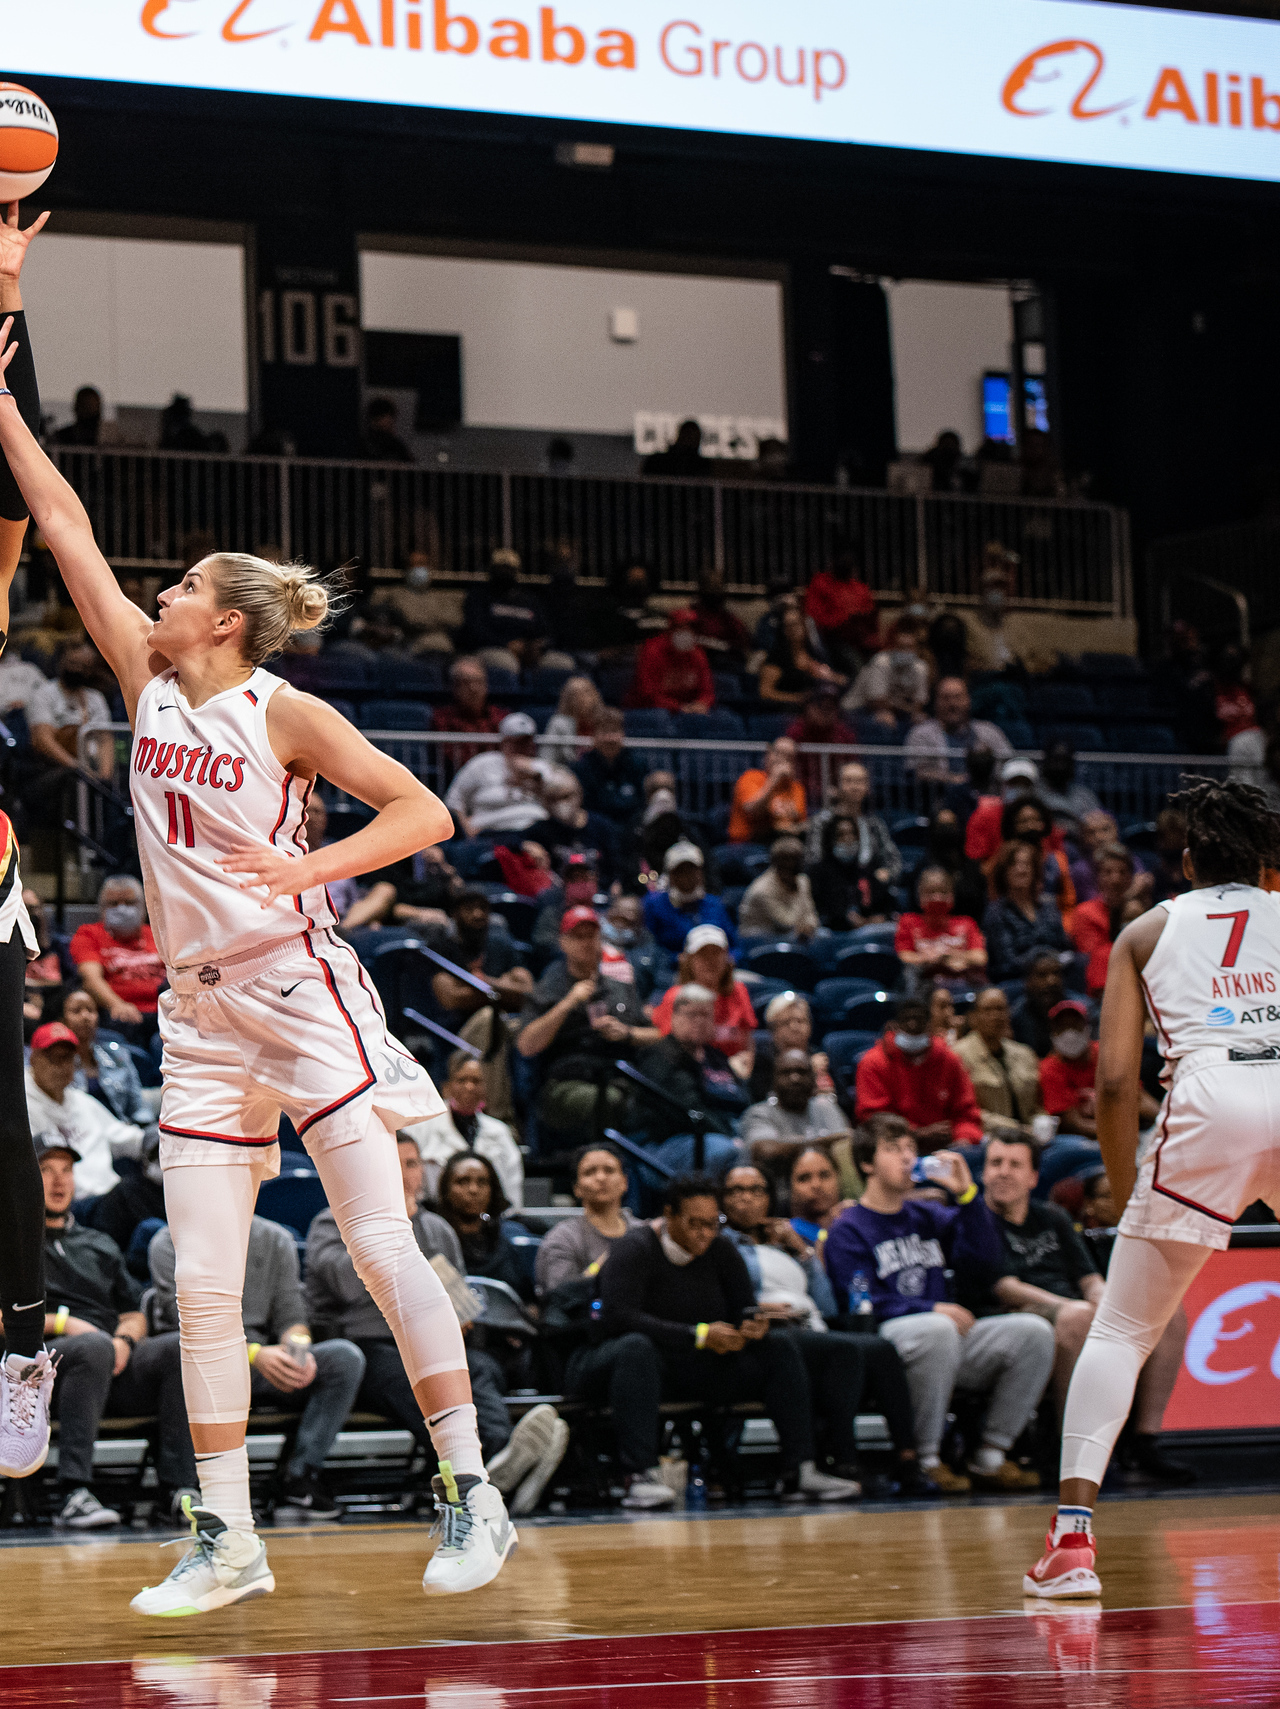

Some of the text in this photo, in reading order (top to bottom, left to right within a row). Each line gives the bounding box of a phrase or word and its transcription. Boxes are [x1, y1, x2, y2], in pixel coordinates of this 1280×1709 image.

[307, 0, 848, 102] Alibaba Group
[1144, 67, 1280, 132] Alib
[260, 289, 360, 367] 106
[164, 791, 195, 848] 11
[1205, 909, 1250, 968] 7
[1211, 971, 1277, 999] ATKINS
